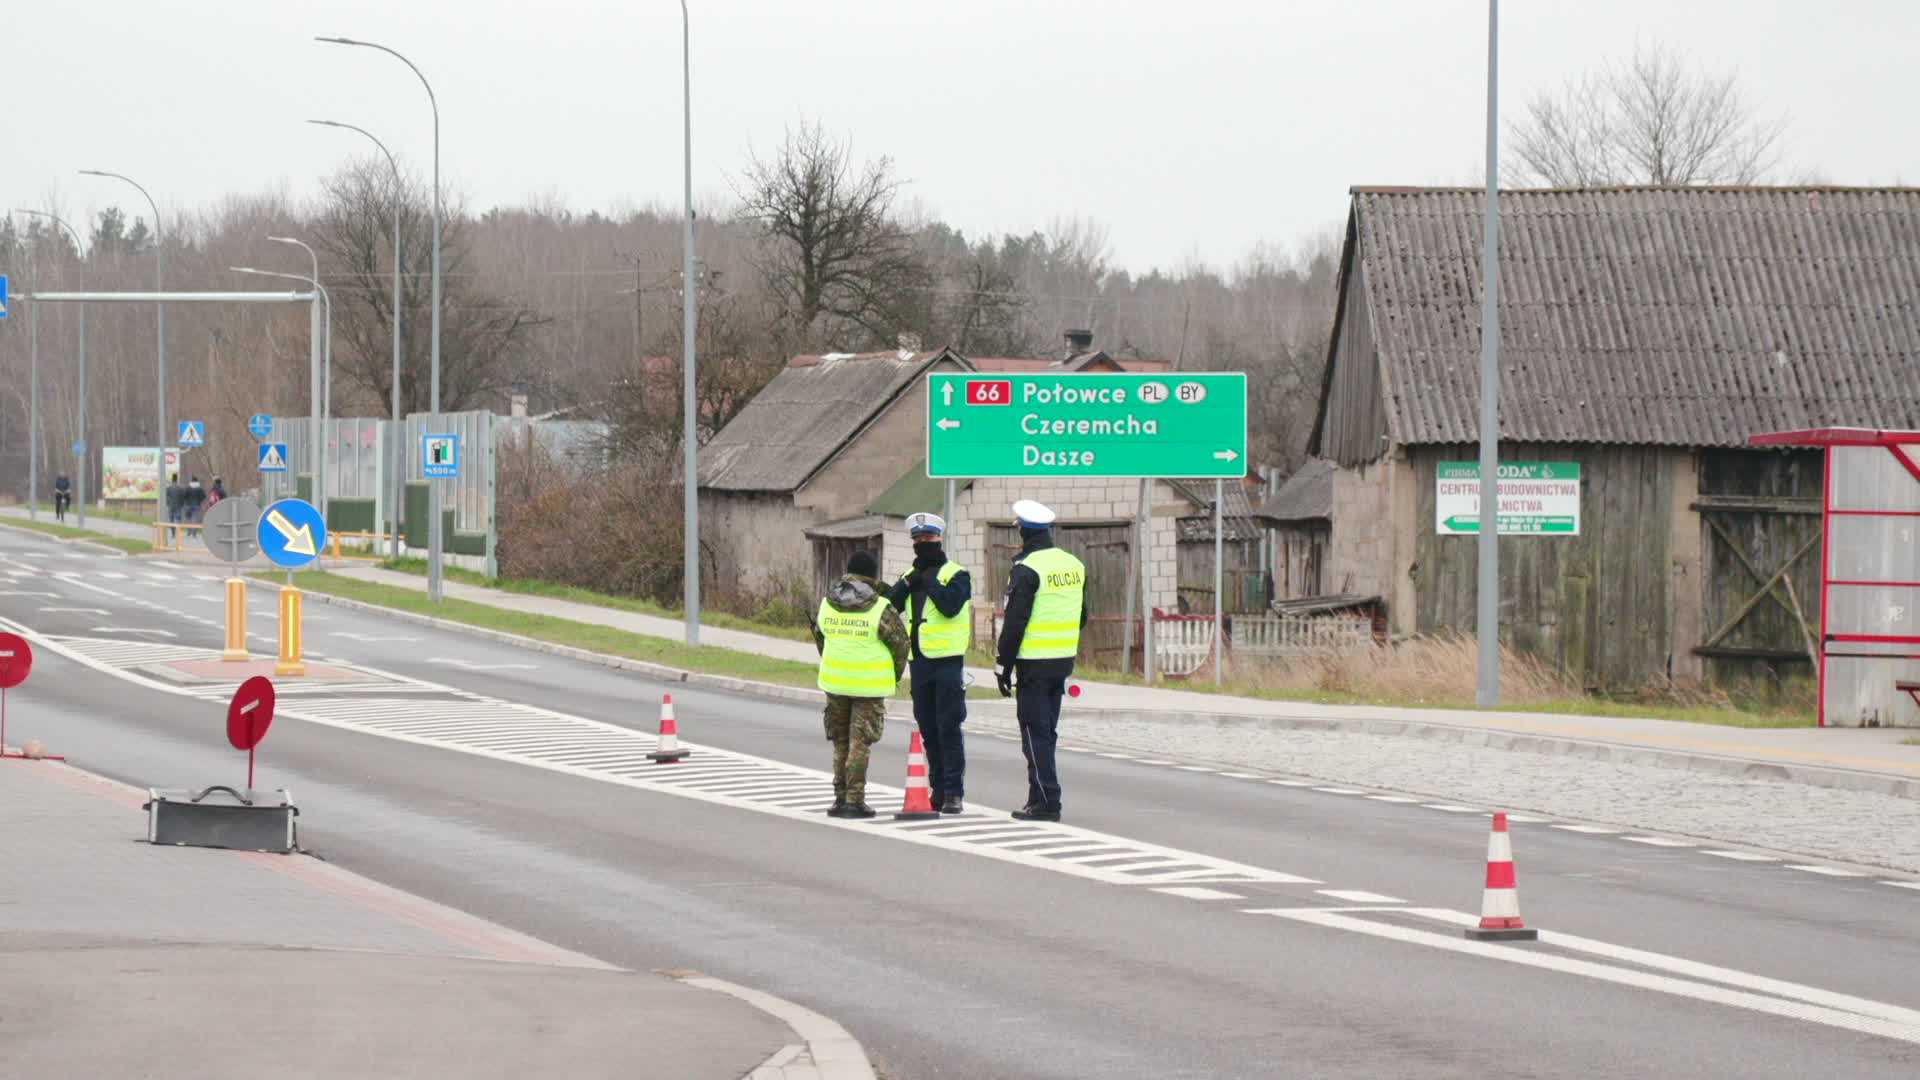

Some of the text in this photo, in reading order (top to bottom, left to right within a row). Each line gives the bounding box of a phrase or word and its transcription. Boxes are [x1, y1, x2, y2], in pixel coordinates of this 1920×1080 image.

[976, 382, 1199, 404] 66 Połowce PL BY
[1022, 413, 1158, 434] Czeremcha
[1023, 445, 1095, 466] Dasze
[1445, 468, 1478, 478] FIRMA
[1440, 483, 1576, 497] CENTRU BUDOWNICTWA
[1047, 572, 1082, 587] POLICJA
